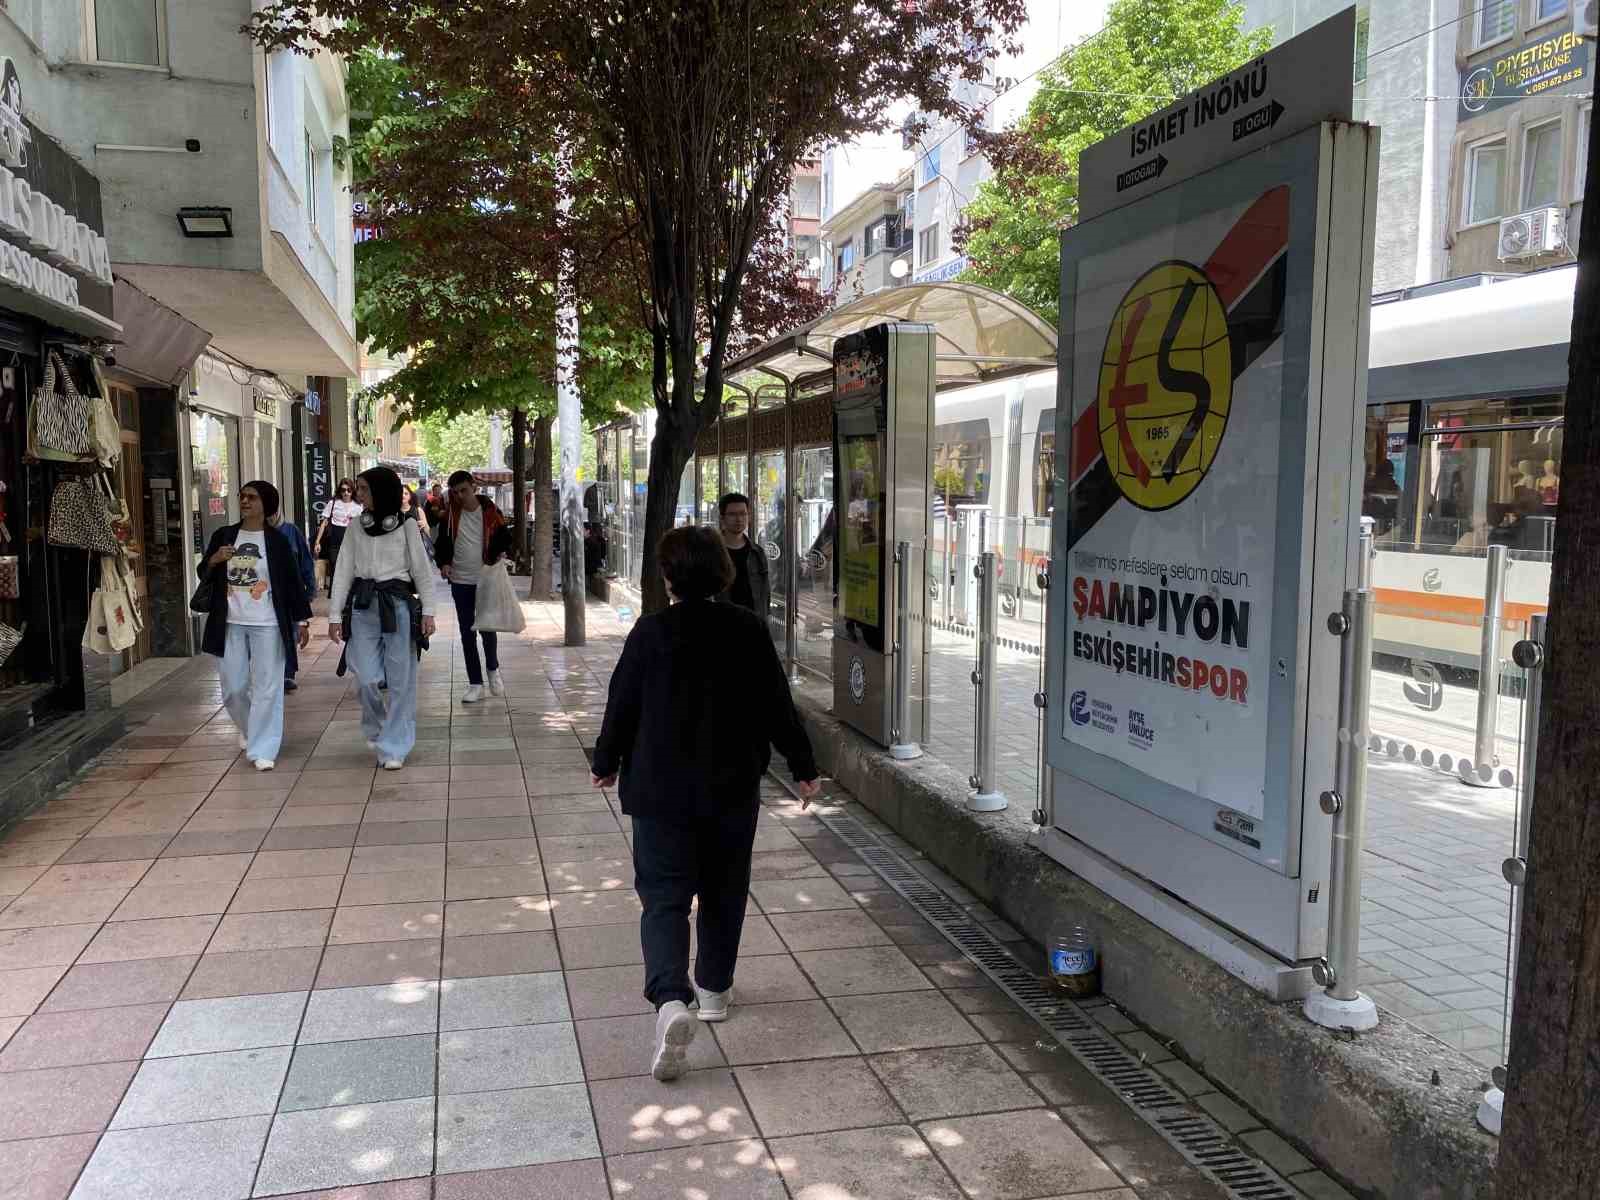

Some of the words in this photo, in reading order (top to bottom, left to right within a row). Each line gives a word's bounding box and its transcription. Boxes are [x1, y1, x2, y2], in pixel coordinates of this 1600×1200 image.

[1130, 106, 1188, 159] İSMET
[1194, 58, 1268, 128] İNÖNÜ
[1125, 162, 1156, 185] OTOGAR
[1145, 426, 1170, 441] 1965
[1120, 556, 1168, 577] nefeslere
[1170, 562, 1208, 582] selam
[1073, 575, 1250, 649] ŞAMPİYON
[1073, 630, 1248, 704] ESKİŞEHİRSPOR
